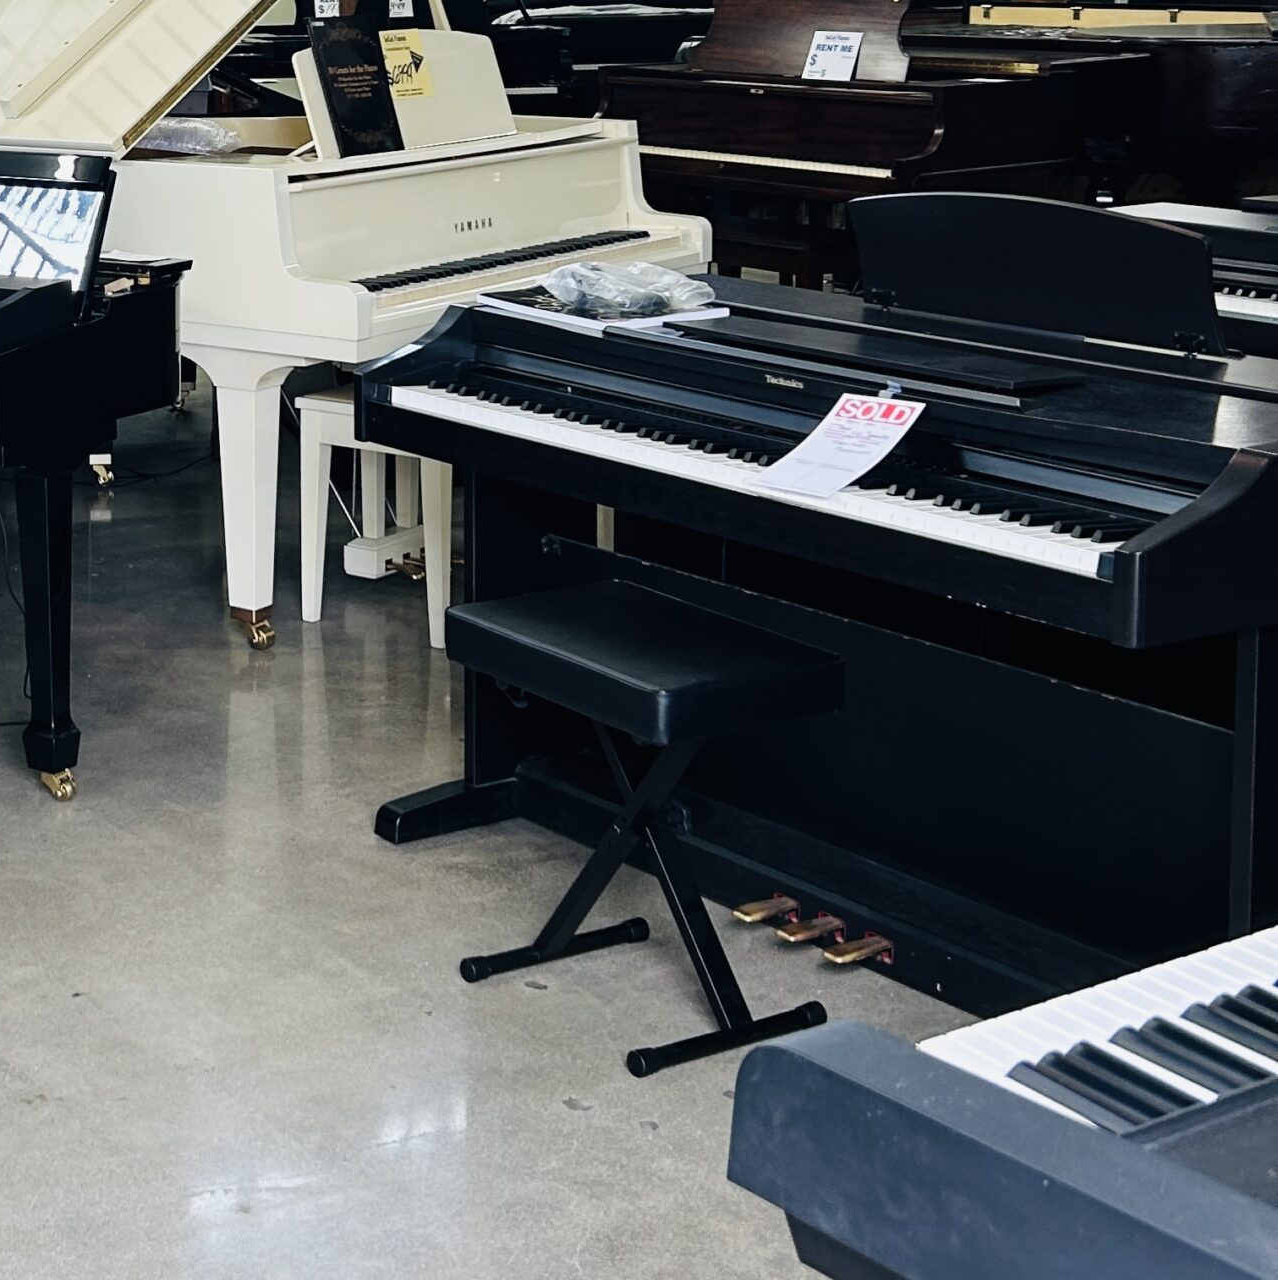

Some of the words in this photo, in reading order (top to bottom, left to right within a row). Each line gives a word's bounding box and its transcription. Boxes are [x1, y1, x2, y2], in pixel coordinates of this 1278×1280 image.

[815, 43, 839, 52] RENT
[840, 44, 854, 53] ME
[453, 217, 494, 234] YAMAHA
[764, 374, 805, 390] Technics
[838, 399, 912, 424] SOLD
